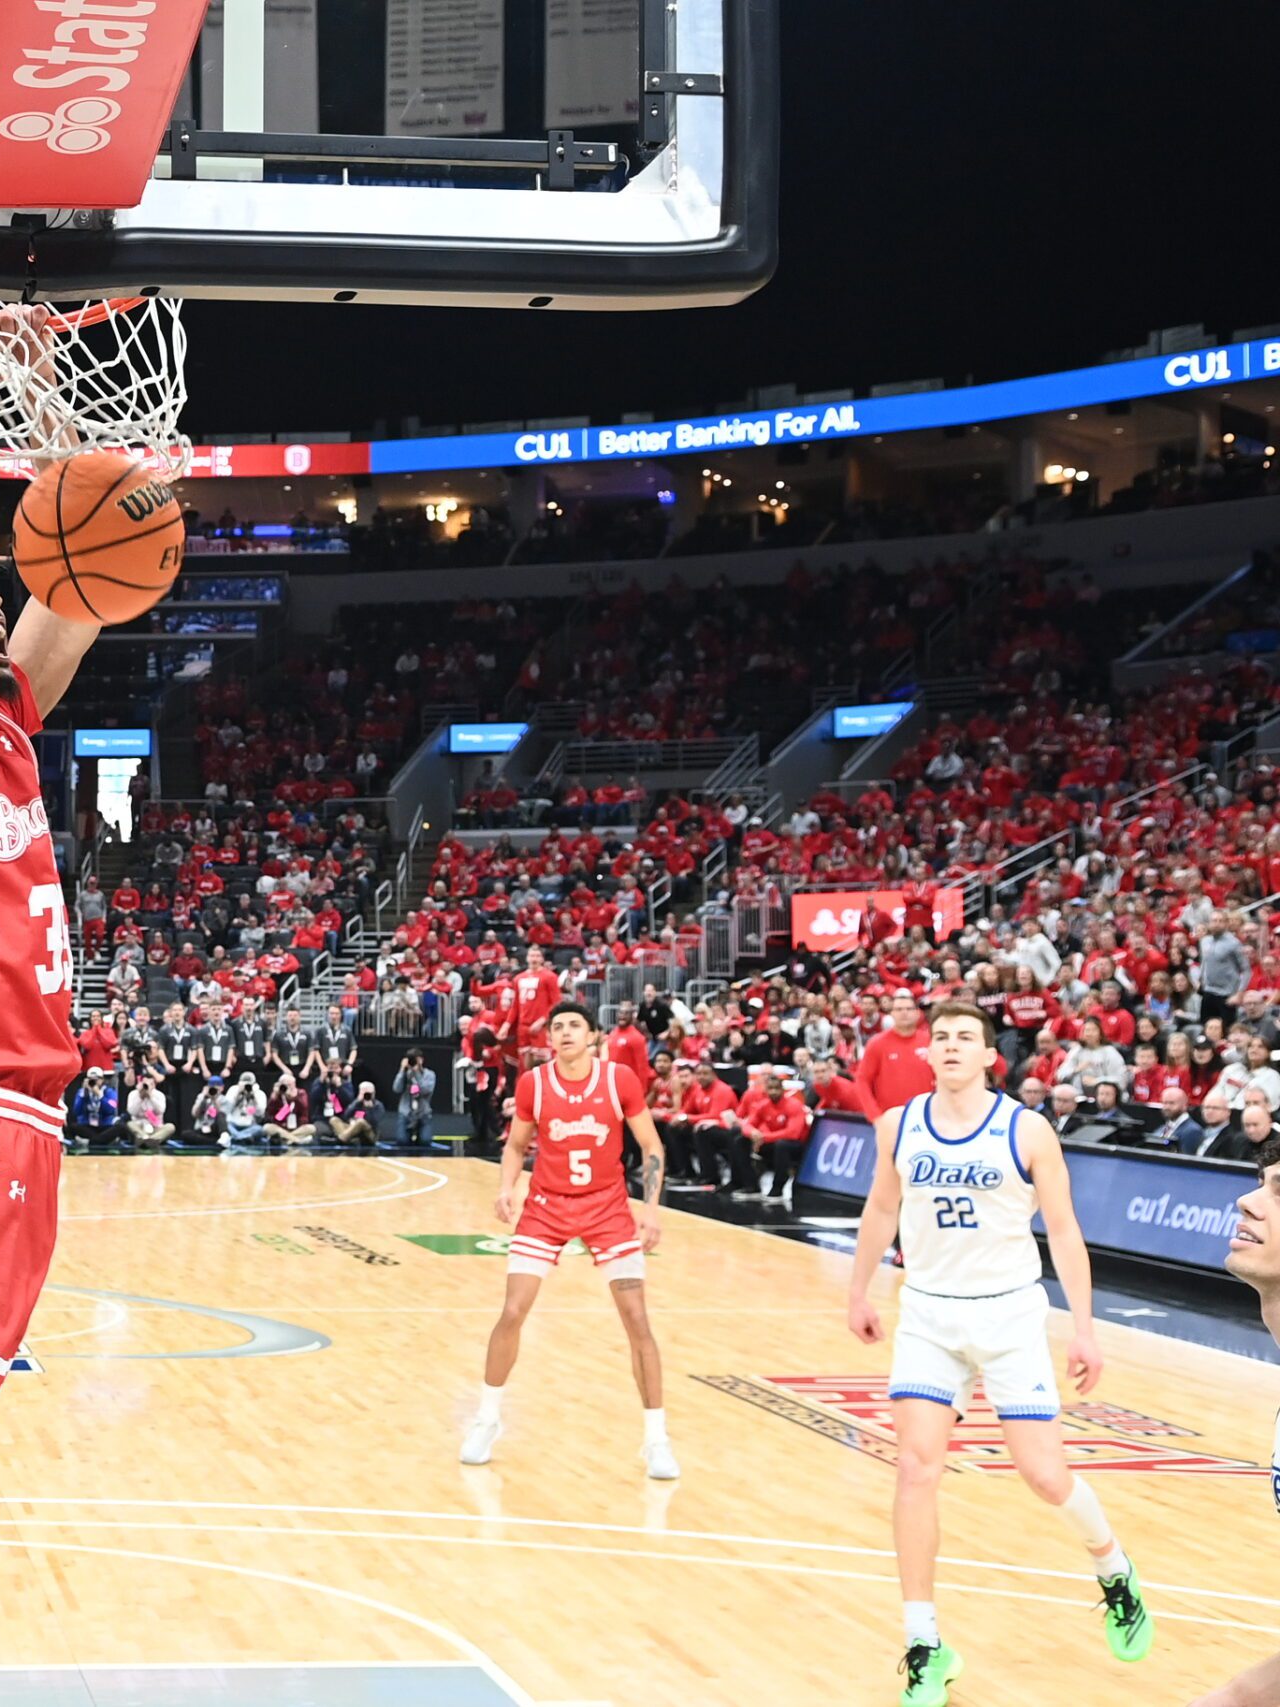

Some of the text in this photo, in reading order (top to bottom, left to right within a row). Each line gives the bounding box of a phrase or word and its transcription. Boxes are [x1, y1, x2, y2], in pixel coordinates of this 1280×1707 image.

[1164, 349, 1232, 387] CU1
[514, 405, 861, 461] CU1 Better Banking For All.
[548, 1114, 610, 1146] Bradley
[568, 1149, 592, 1186] 5
[816, 1132, 865, 1179] CU1
[909, 1151, 1003, 1191] Drake
[933, 1196, 978, 1229] 22
